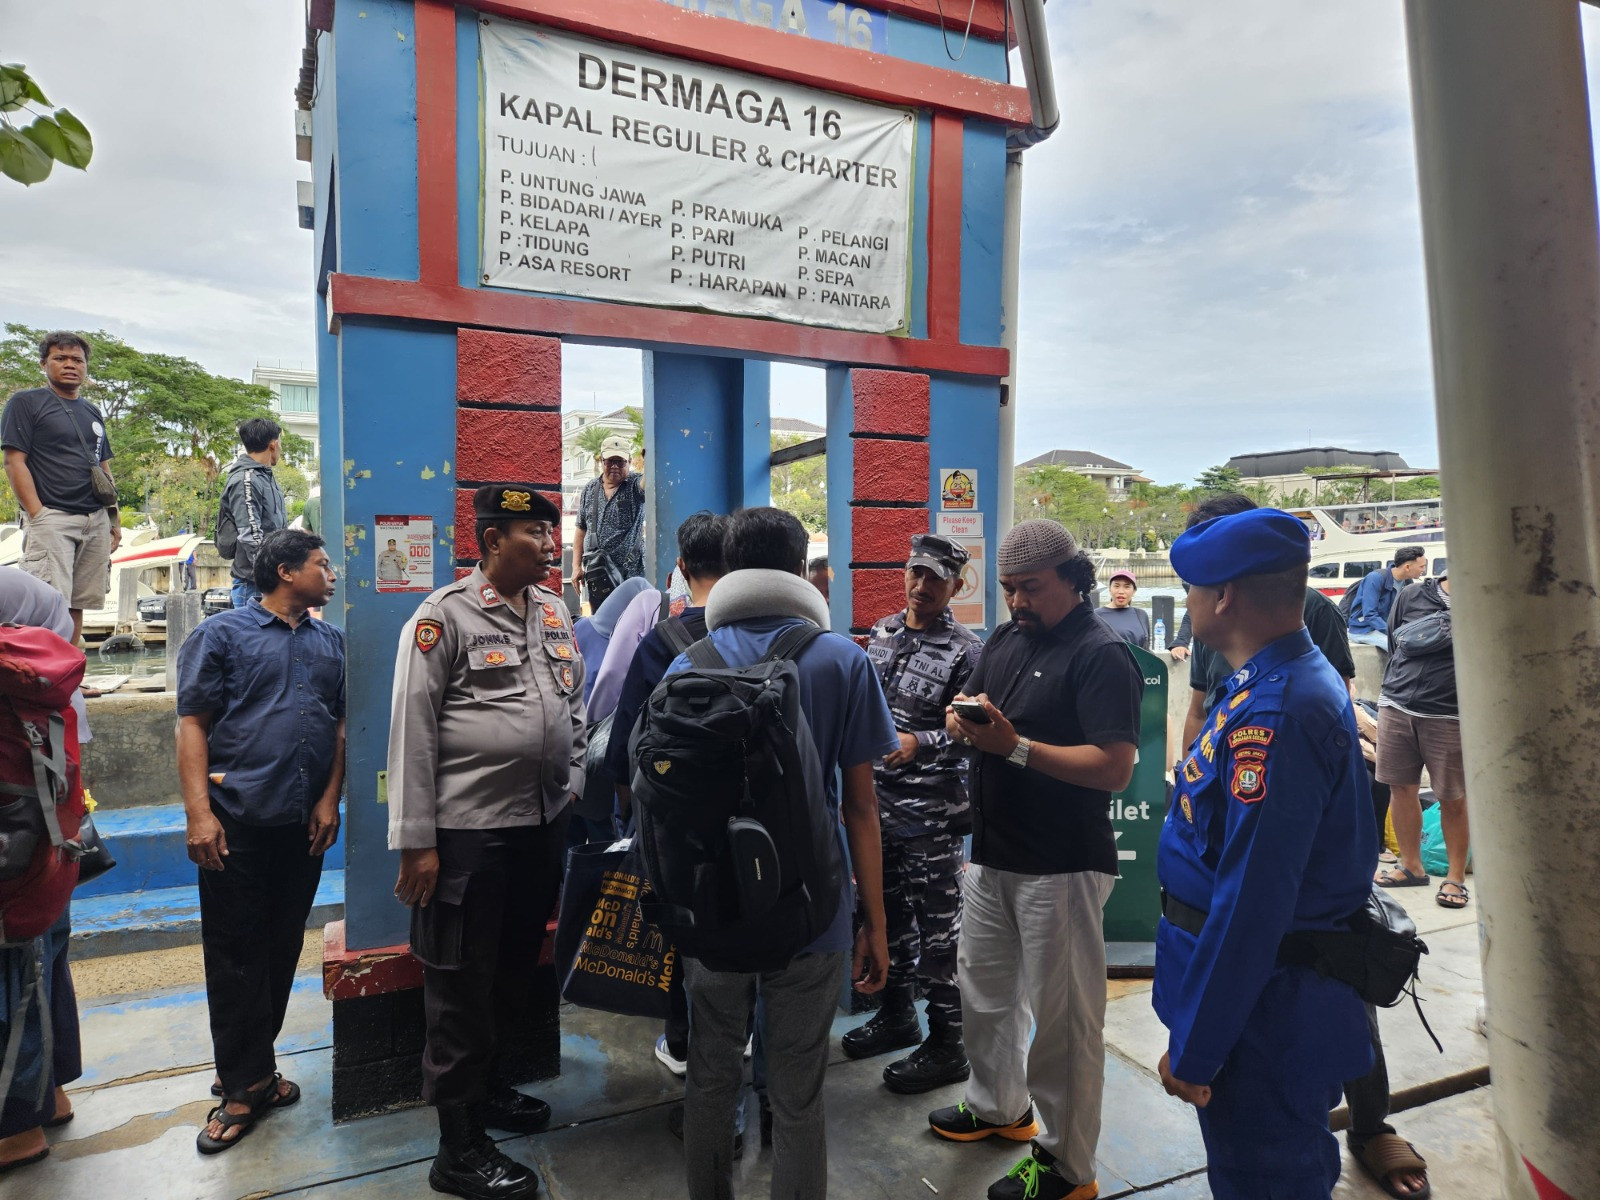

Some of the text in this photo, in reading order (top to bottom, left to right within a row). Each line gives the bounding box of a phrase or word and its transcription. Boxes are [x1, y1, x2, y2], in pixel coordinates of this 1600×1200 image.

[660, 0, 873, 51] AGA 16
[578, 52, 842, 140] DERMAGA 16
[497, 134, 575, 164] TUJUAN
[500, 92, 898, 189] KAPAL REGULER & CHARTER
[501, 169, 646, 207] P. UNTUNG JAWA
[501, 189, 514, 205] P.
[520, 193, 605, 220] BIDADARI
[618, 209, 662, 228] AYER
[671, 199, 783, 232] P. PRAMUKA
[501, 210, 591, 237] P. KELAPA
[671, 222, 735, 246] P. PARI
[821, 229, 889, 251] PELANGI
[499, 251, 631, 282] P. ASA RESORT
[671, 245, 746, 271] P. PUTRI
[798, 246, 871, 269] P. MACAN
[699, 272, 787, 298] HARAPAN
[798, 265, 855, 287] P. SEPA
[821, 289, 891, 310] PANTARA
[943, 516, 977, 525] Please Keep
[951, 525, 968, 534] Clean
[914, 659, 944, 678] TNI AL
[1144, 674, 1161, 685] col
[1233, 729, 1265, 740] POLRES
[596, 897, 621, 912] McD
[590, 908, 618, 928] on
[585, 926, 613, 940] ald's
[579, 940, 659, 970] McDonald's
[573, 956, 656, 987] McDonald's
